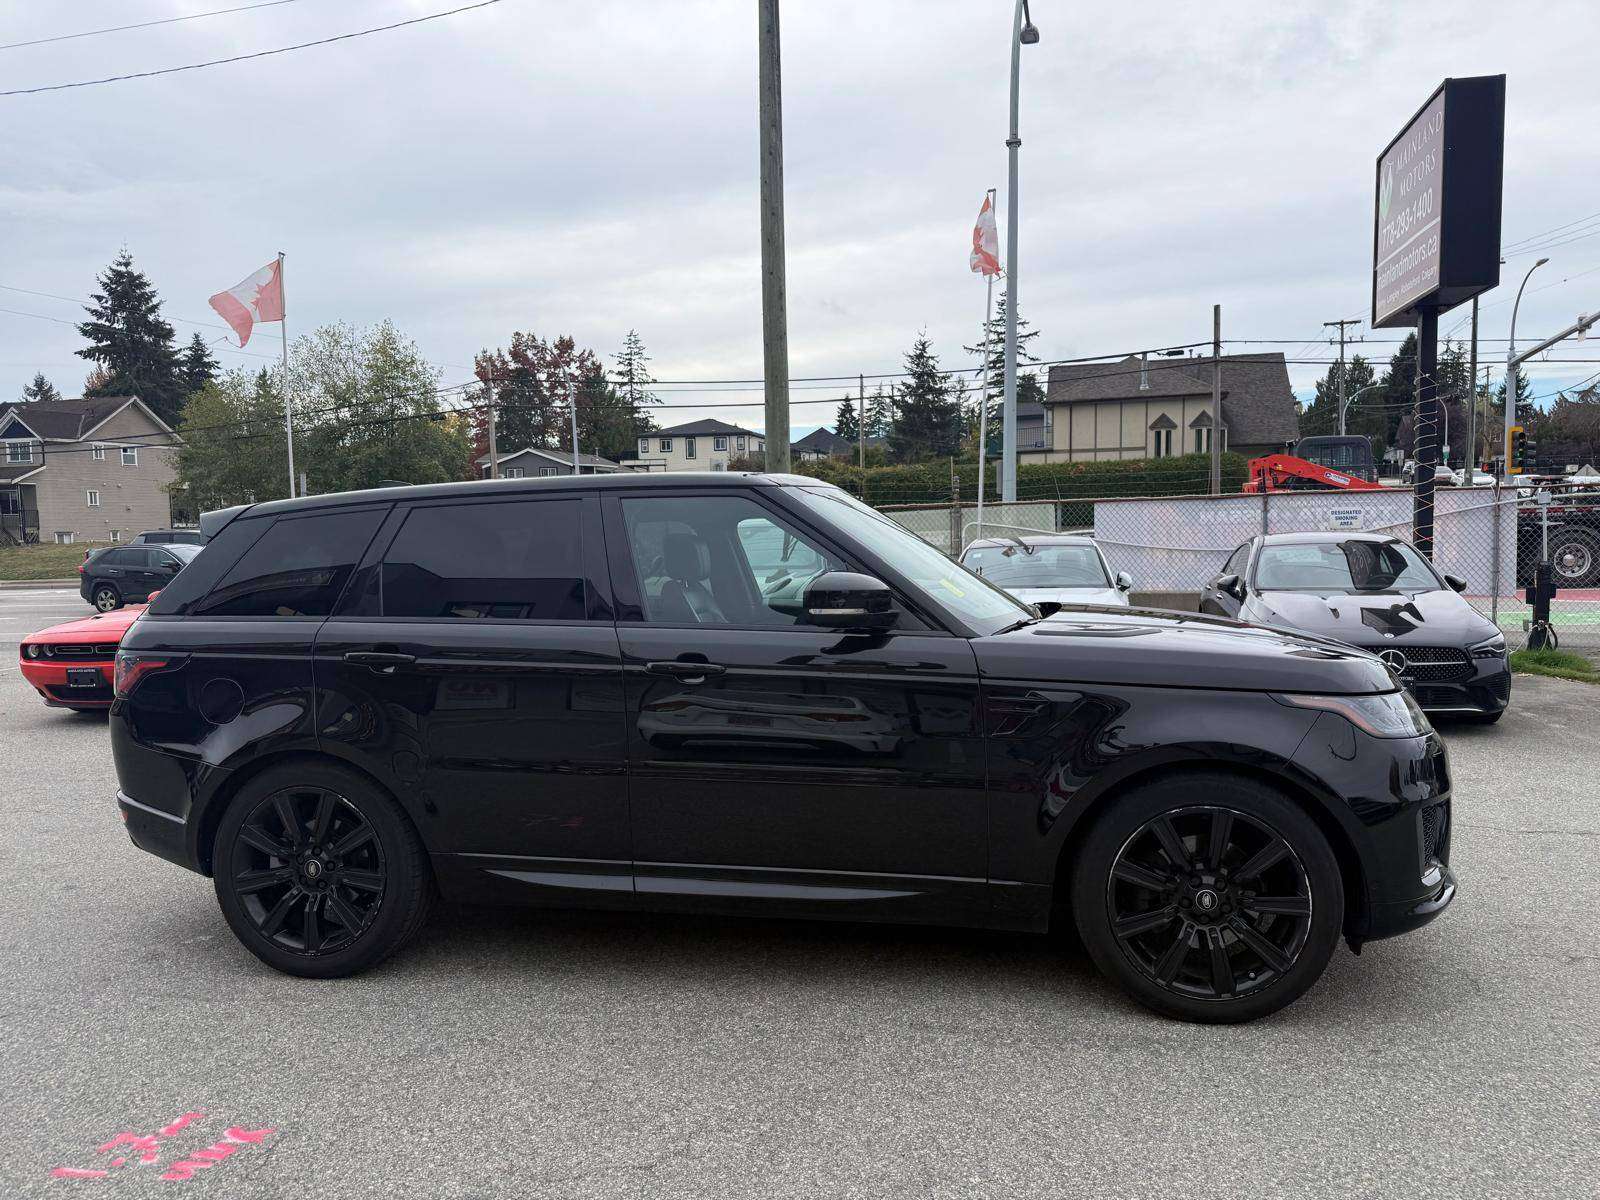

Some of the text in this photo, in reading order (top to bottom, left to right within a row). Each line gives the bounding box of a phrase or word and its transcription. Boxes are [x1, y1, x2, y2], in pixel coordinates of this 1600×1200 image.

[1396, 111, 1443, 171] MAINLAND
[1400, 148, 1437, 197] MOTORS
[1382, 187, 1433, 251] 778-293-1400
[1377, 234, 1438, 290] mainlandmotors.ca
